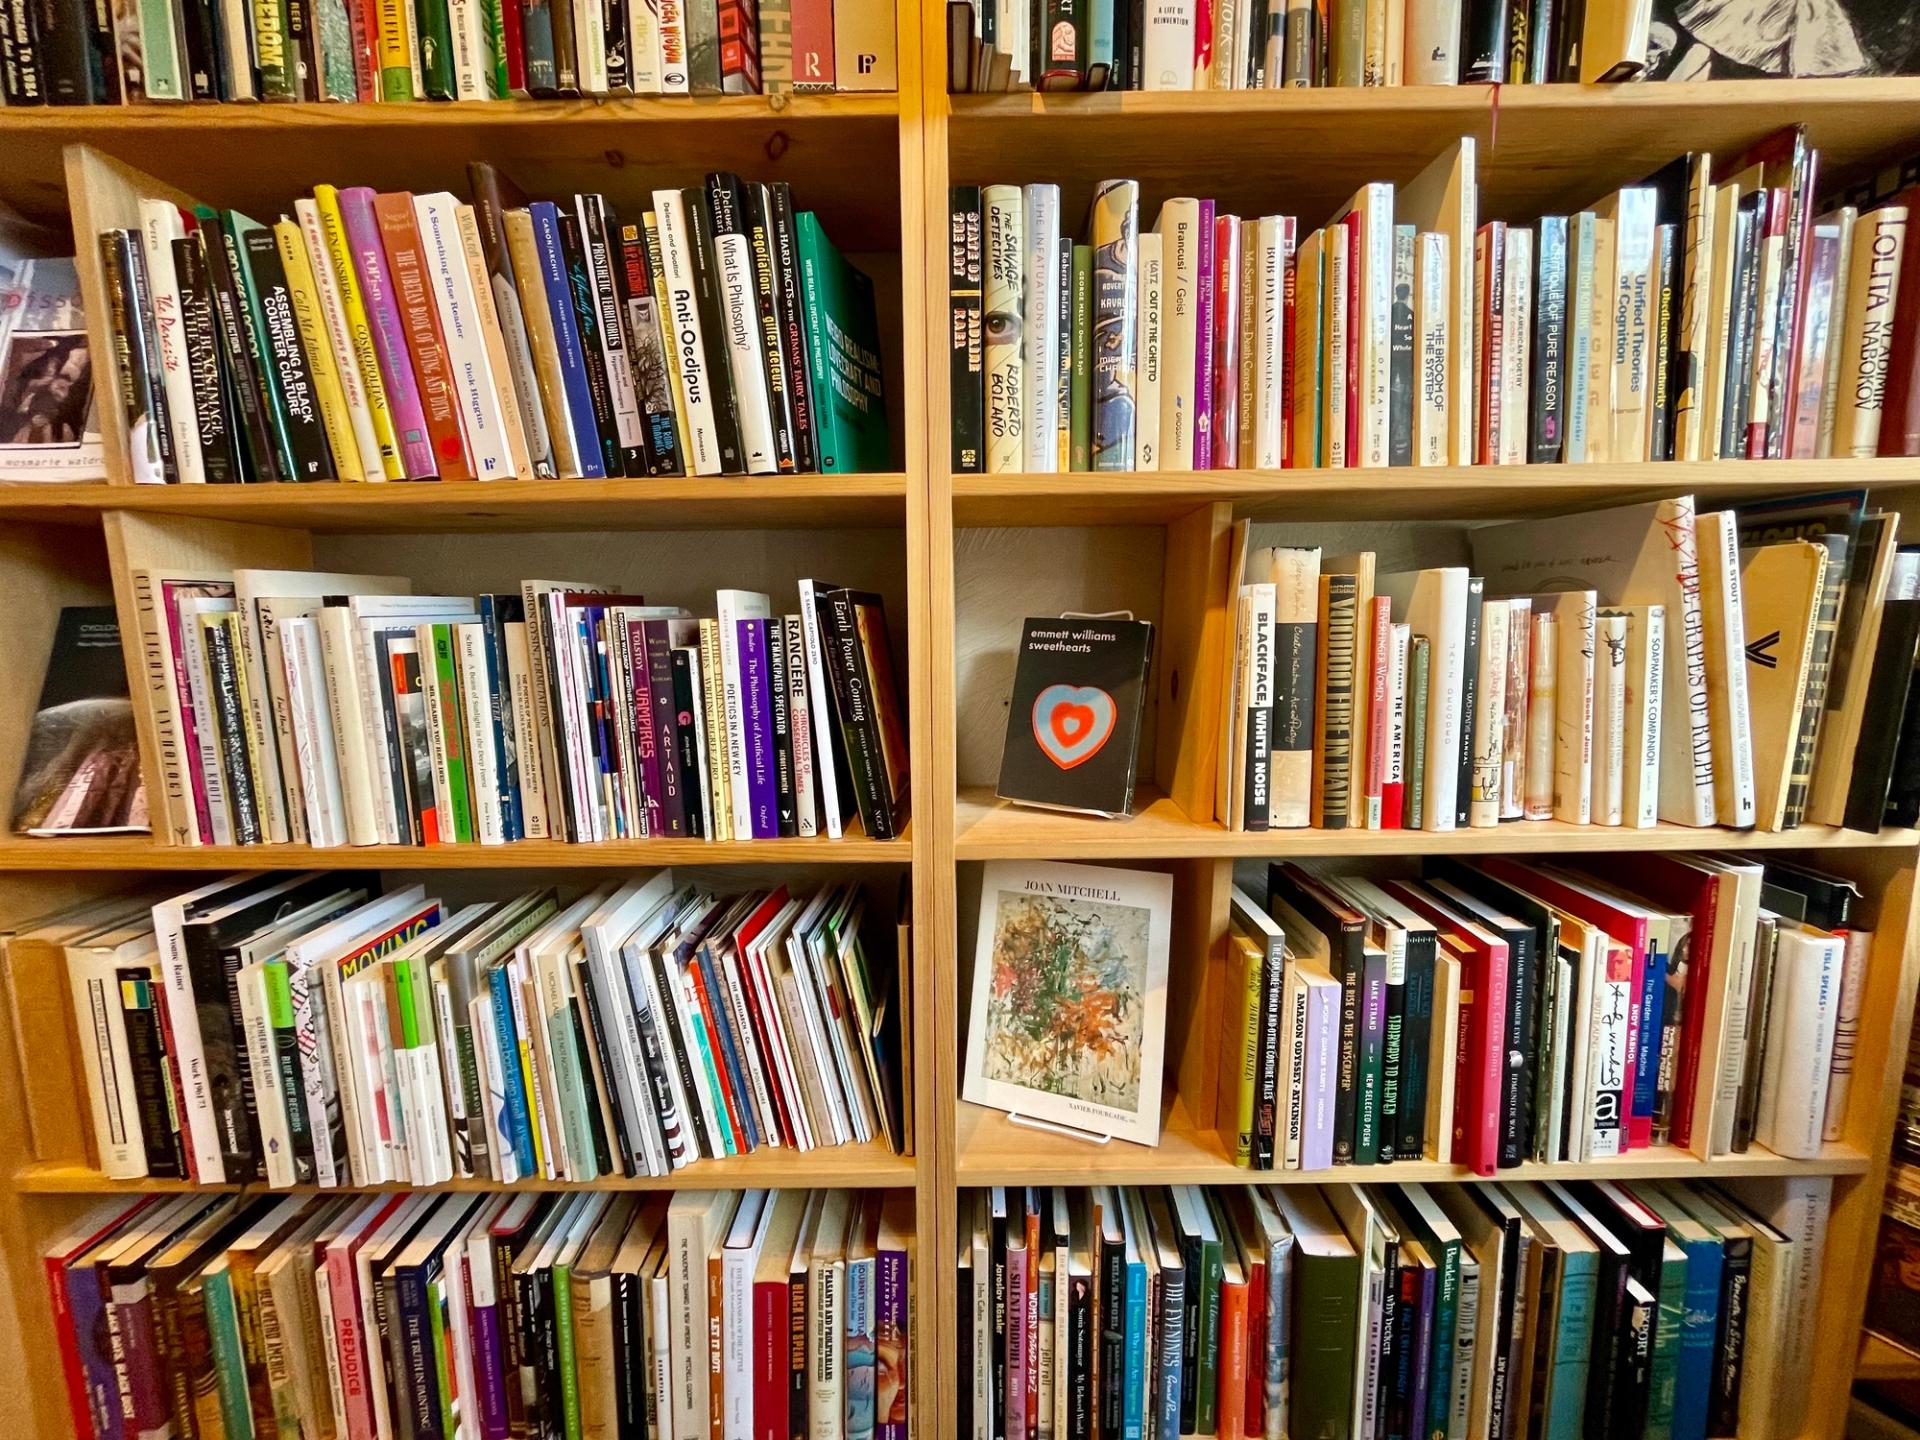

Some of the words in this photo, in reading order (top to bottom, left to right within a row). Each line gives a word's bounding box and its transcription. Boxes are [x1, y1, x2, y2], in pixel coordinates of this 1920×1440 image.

[660, 26, 682, 64] WISDOM
[663, 202, 675, 232] Deleuze
[711, 190, 723, 233] Guattari
[721, 190, 735, 232] Deleuze
[953, 213, 965, 242] THE
[1004, 213, 1013, 230] THE
[430, 216, 452, 274] Something
[541, 217, 560, 282] CANON/ARCHIVE
[667, 234, 677, 247] and
[779, 234, 793, 267] HARD
[966, 212, 979, 258] STATE
[991, 206, 1004, 280] DETECTIVES
[1176, 222, 1188, 270] Brancusi
[322, 211, 340, 247] ALLEN
[331, 249, 354, 304] GINSBERG
[591, 243, 614, 294] PROSTHETIC
[669, 250, 682, 279] Guattari
[721, 238, 741, 270] What
[752, 226, 773, 295] negotiations
[953, 245, 965, 276] ART
[1004, 235, 1020, 291] SAVAGE
[1061, 252, 1069, 286] Roberto
[1265, 247, 1275, 273] BOB
[1866, 221, 1906, 311] LOLITA
[444, 277, 457, 299] Else
[727, 272, 741, 282] Is
[783, 268, 796, 298] FACTS
[968, 263, 979, 281] OF
[1149, 260, 1158, 284] KATZ
[1619, 276, 1631, 292] of
[155, 294, 174, 316] The
[786, 299, 795, 307] OF
[788, 309, 797, 321] THE
[1060, 289, 1070, 320] Bolaño
[1148, 291, 1158, 308] OUT
[1148, 310, 1158, 321] OF
[1176, 288, 1187, 316] Geist
[1265, 278, 1275, 323] DYLAN
[1632, 274, 1646, 326] Unified
[273, 286, 301, 367] ASSEMBLING
[450, 302, 464, 340] Reader
[599, 295, 620, 347] TERRITORIES
[728, 284, 750, 351] Philosophy?
[762, 316, 780, 347] gilles
[954, 308, 966, 349] KAEL
[1148, 324, 1158, 343] THE
[1434, 321, 1445, 346] THE
[1616, 294, 1631, 364] Cognition
[160, 319, 179, 373] Parasite
[675, 290, 703, 403] Anti-Oedipus
[788, 322, 803, 367] GRIMMS'
[968, 309, 980, 373] PAULINE
[1060, 332, 1069, 343] BY
[1425, 331, 1435, 355] THE
[1546, 325, 1559, 357] PURE
[264, 297, 285, 357] COUNTER
[279, 361, 301, 416] CULTURE
[355, 324, 384, 410] COSMOPOLITAN
[463, 362, 476, 386] Dick
[768, 350, 783, 392] deleuze
[1060, 347, 1069, 381] NIGHT
[1148, 345, 1158, 382] GHETTO
[1264, 327, 1273, 389] CHRONICLES
[1434, 348, 1444, 392] BROOM
[1631, 330, 1644, 392] Theories
[1854, 322, 1882, 410] NABOKOV
[294, 370, 304, 381] A
[793, 370, 806, 397] FAIRY
[1060, 385, 1069, 395] IN
[1425, 357, 1435, 401] SYSTEM
[1545, 361, 1558, 411] REASON
[295, 381, 314, 424] BLACK
[470, 388, 486, 429] Higgins
[797, 401, 809, 430] TALES
[991, 373, 1007, 437] BOLAÑO
[1007, 364, 1021, 437] ROBERTO
[1434, 394, 1444, 412] OF
[697, 428, 708, 463] Minnesota
[778, 429, 788, 454] COLUMBIA
[1680, 562, 1702, 604] THE
[770, 625, 781, 639] THE
[833, 601, 847, 631] Earth
[632, 630, 644, 671] TOLSTOY
[748, 632, 757, 653] Boden
[1028, 640, 1091, 653] sweethearts
[1031, 629, 1069, 639] emmett
[1072, 628, 1117, 642] williams
[1327, 598, 1354, 687] VOODOO
[1683, 609, 1711, 687] GRAPES
[748, 659, 757, 673] The
[771, 642, 784, 692] EMANCIPATED
[789, 620, 806, 697] RANCIÈRE
[842, 637, 857, 673] Power
[1254, 612, 1268, 706] BLACKFACE,
[1649, 638, 1660, 703] SOAPMAKER'S
[747, 675, 761, 720] Philosophy
[775, 695, 786, 735] SPECTATOR
[849, 678, 865, 721] Coming
[1326, 693, 1352, 734] FIRE
[1689, 693, 1711, 717] OF
[636, 687, 654, 758] VAMPIRES
[752, 722, 761, 731] of
[792, 709, 803, 763] CONSENSUAL
[799, 709, 810, 759] CHRONICLES
[1255, 710, 1266, 757] WHITE
[1645, 706, 1658, 766] COMPANION
[753, 732, 765, 771] Artificial
[1325, 739, 1350, 757] IN
[1691, 725, 1715, 787] RALPH
[755, 773, 765, 785] Life
[794, 765, 805, 794] TIMES
[802, 762, 811, 774] OF
[1254, 762, 1267, 805] NOISE
[1324, 762, 1348, 815] HAITI
[759, 805, 768, 828] Oxford
[1024, 880, 1053, 893] JOAN
[1369, 980, 1379, 1000] MARK
[1368, 1002, 1378, 1030] STRAND
[1630, 1004, 1639, 1025] ANDY
[1386, 1015, 1401, 1063] STAIRWAYS
[1627, 1029, 1637, 1064] WARHOL
[280, 1056, 291, 1074] BLUE
[1365, 1073, 1374, 1088] NEW
[1385, 1065, 1399, 1076] TO
[284, 1077, 295, 1096] NOTE
[1383, 1080, 1398, 1114] HEAVEN
[287, 1098, 301, 1132] RECORDS
[1363, 1090, 1374, 1122] SELECTED
[1362, 1125, 1371, 1147] POEMS
[994, 1263, 1005, 1300] Jaroslav
[1443, 1247, 1457, 1301] Baudelaire
[792, 1283, 804, 1313] BLACK
[1009, 1273, 1021, 1313] SILENT
[1165, 1282, 1183, 1303] THE
[1384, 1294, 1395, 1316] why
[792, 1316, 804, 1332] ELK
[995, 1303, 1005, 1335] Rössler
[1383, 1318, 1395, 1355] beckett
[792, 1334, 804, 1369] SPEAKS
[1009, 1317, 1020, 1369] PROPHET
[1163, 1309, 1181, 1367] EVENINGS
[341, 1318, 361, 1396] PREJUDICE
[1040, 1347, 1051, 1367] jelly
[1041, 1369, 1051, 1386] roll
